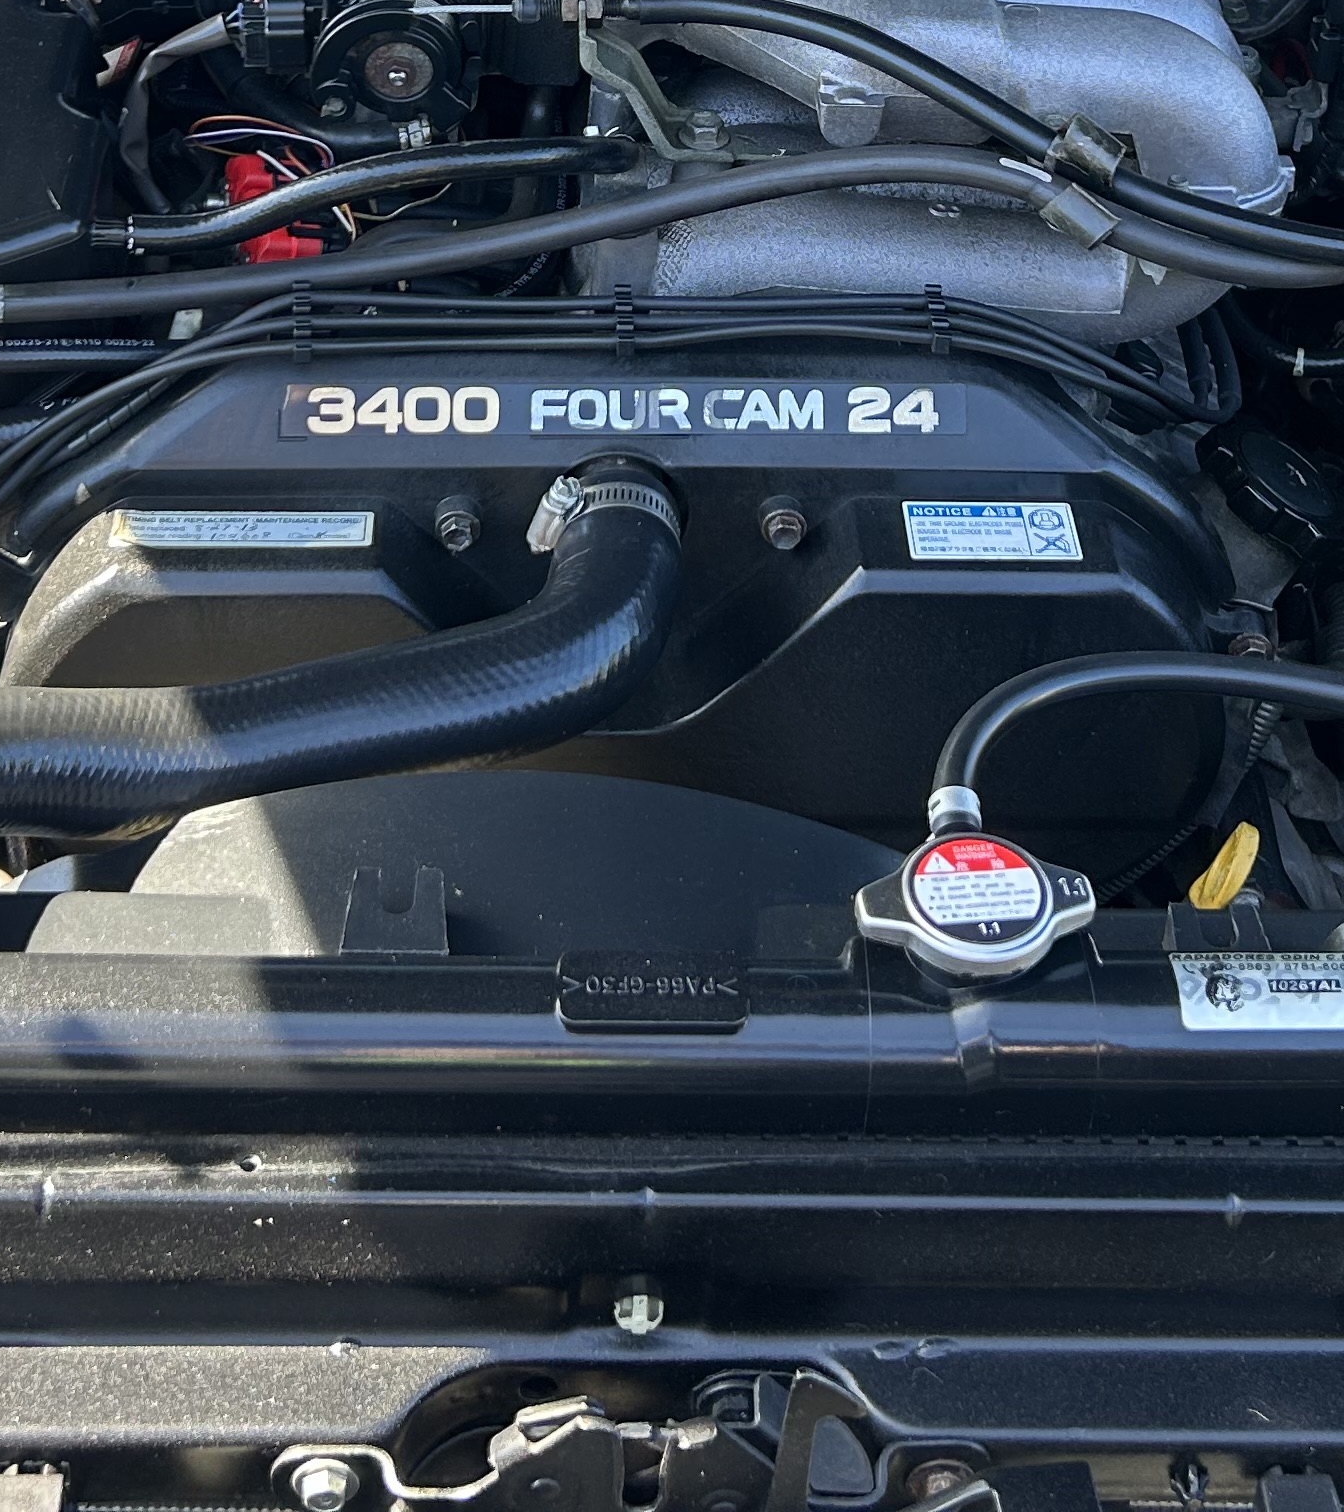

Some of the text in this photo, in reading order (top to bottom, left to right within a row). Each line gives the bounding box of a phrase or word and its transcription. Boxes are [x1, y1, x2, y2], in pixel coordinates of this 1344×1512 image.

[307, 386, 941, 435] 3400 FOUR CAM 24
[912, 507, 972, 516] NOTICE
[978, 921, 1001, 937] 1.1
[1269, 979, 1342, 992] 10261AL
